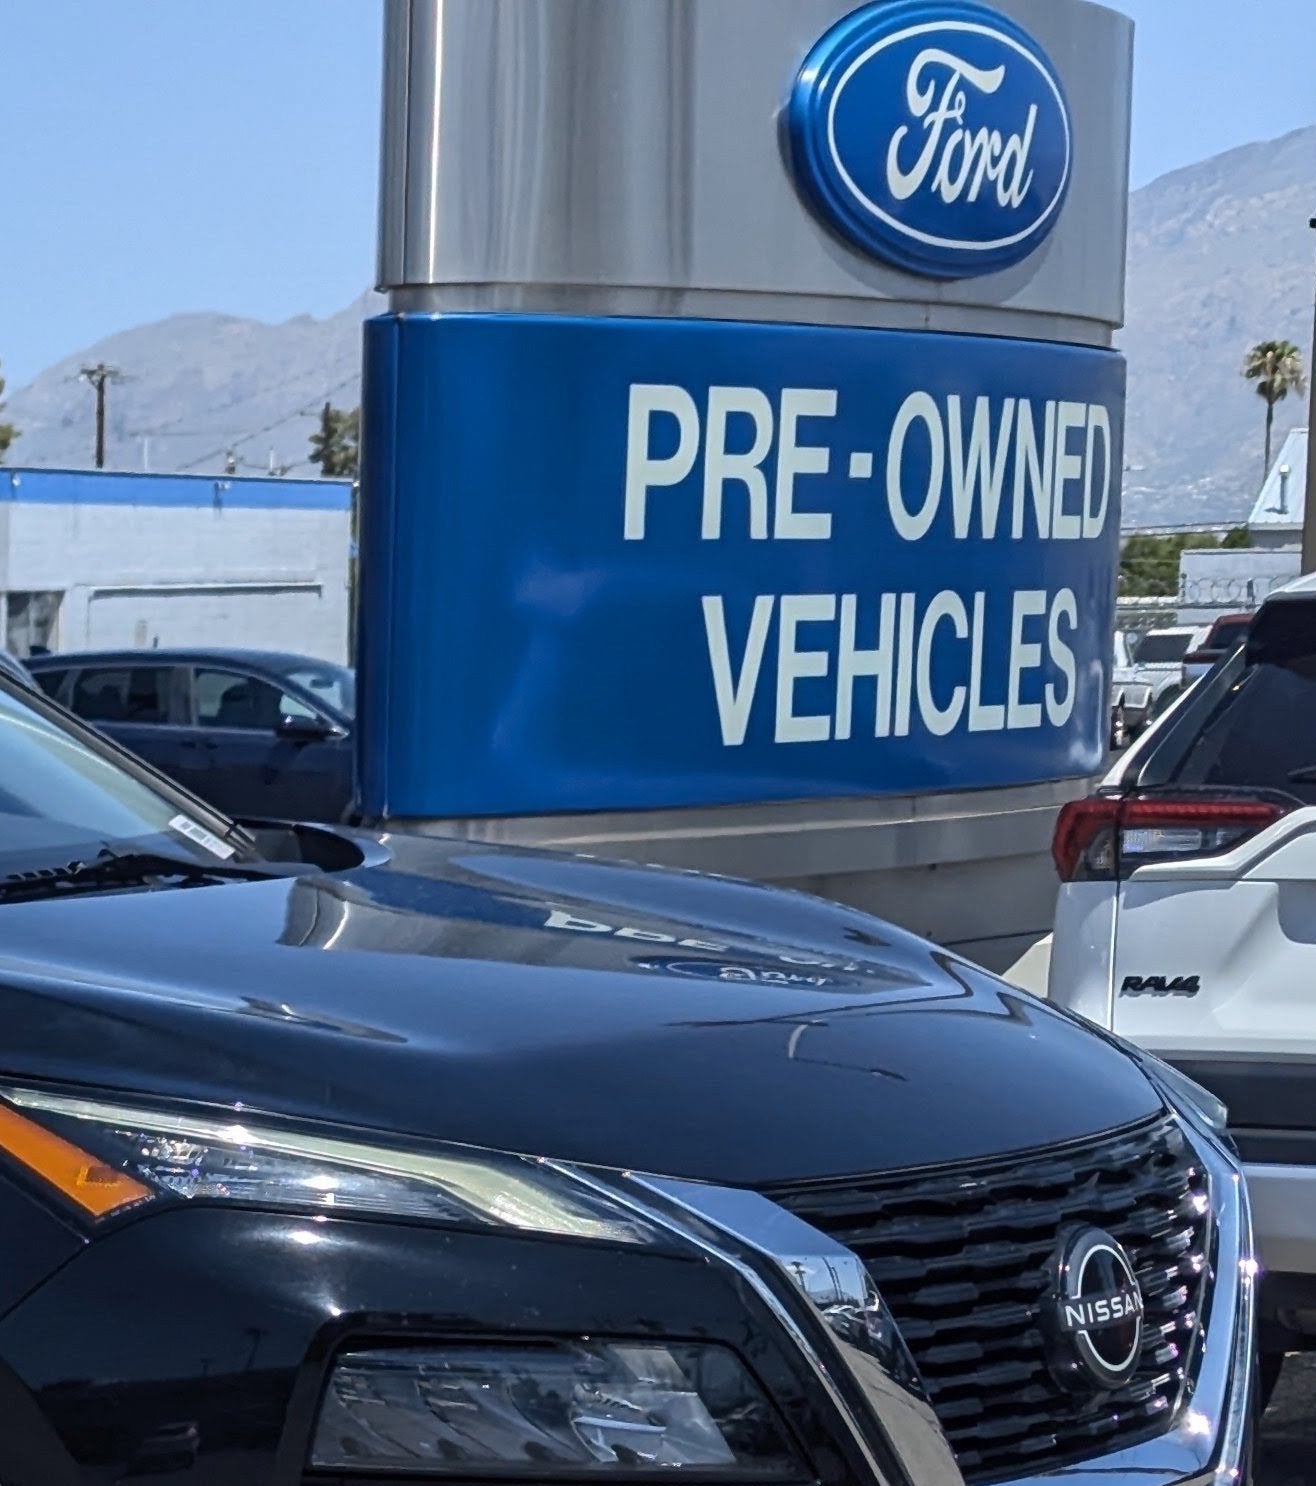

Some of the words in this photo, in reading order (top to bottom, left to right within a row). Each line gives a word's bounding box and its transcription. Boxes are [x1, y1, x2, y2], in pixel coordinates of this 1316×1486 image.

[886, 48, 1038, 209] Ford
[624, 383, 1112, 541] PRE-OWNED
[701, 587, 1078, 746] VEHICLES
[1120, 976, 1200, 993] RAV4
[1065, 1291, 1143, 1327] NISSAN
